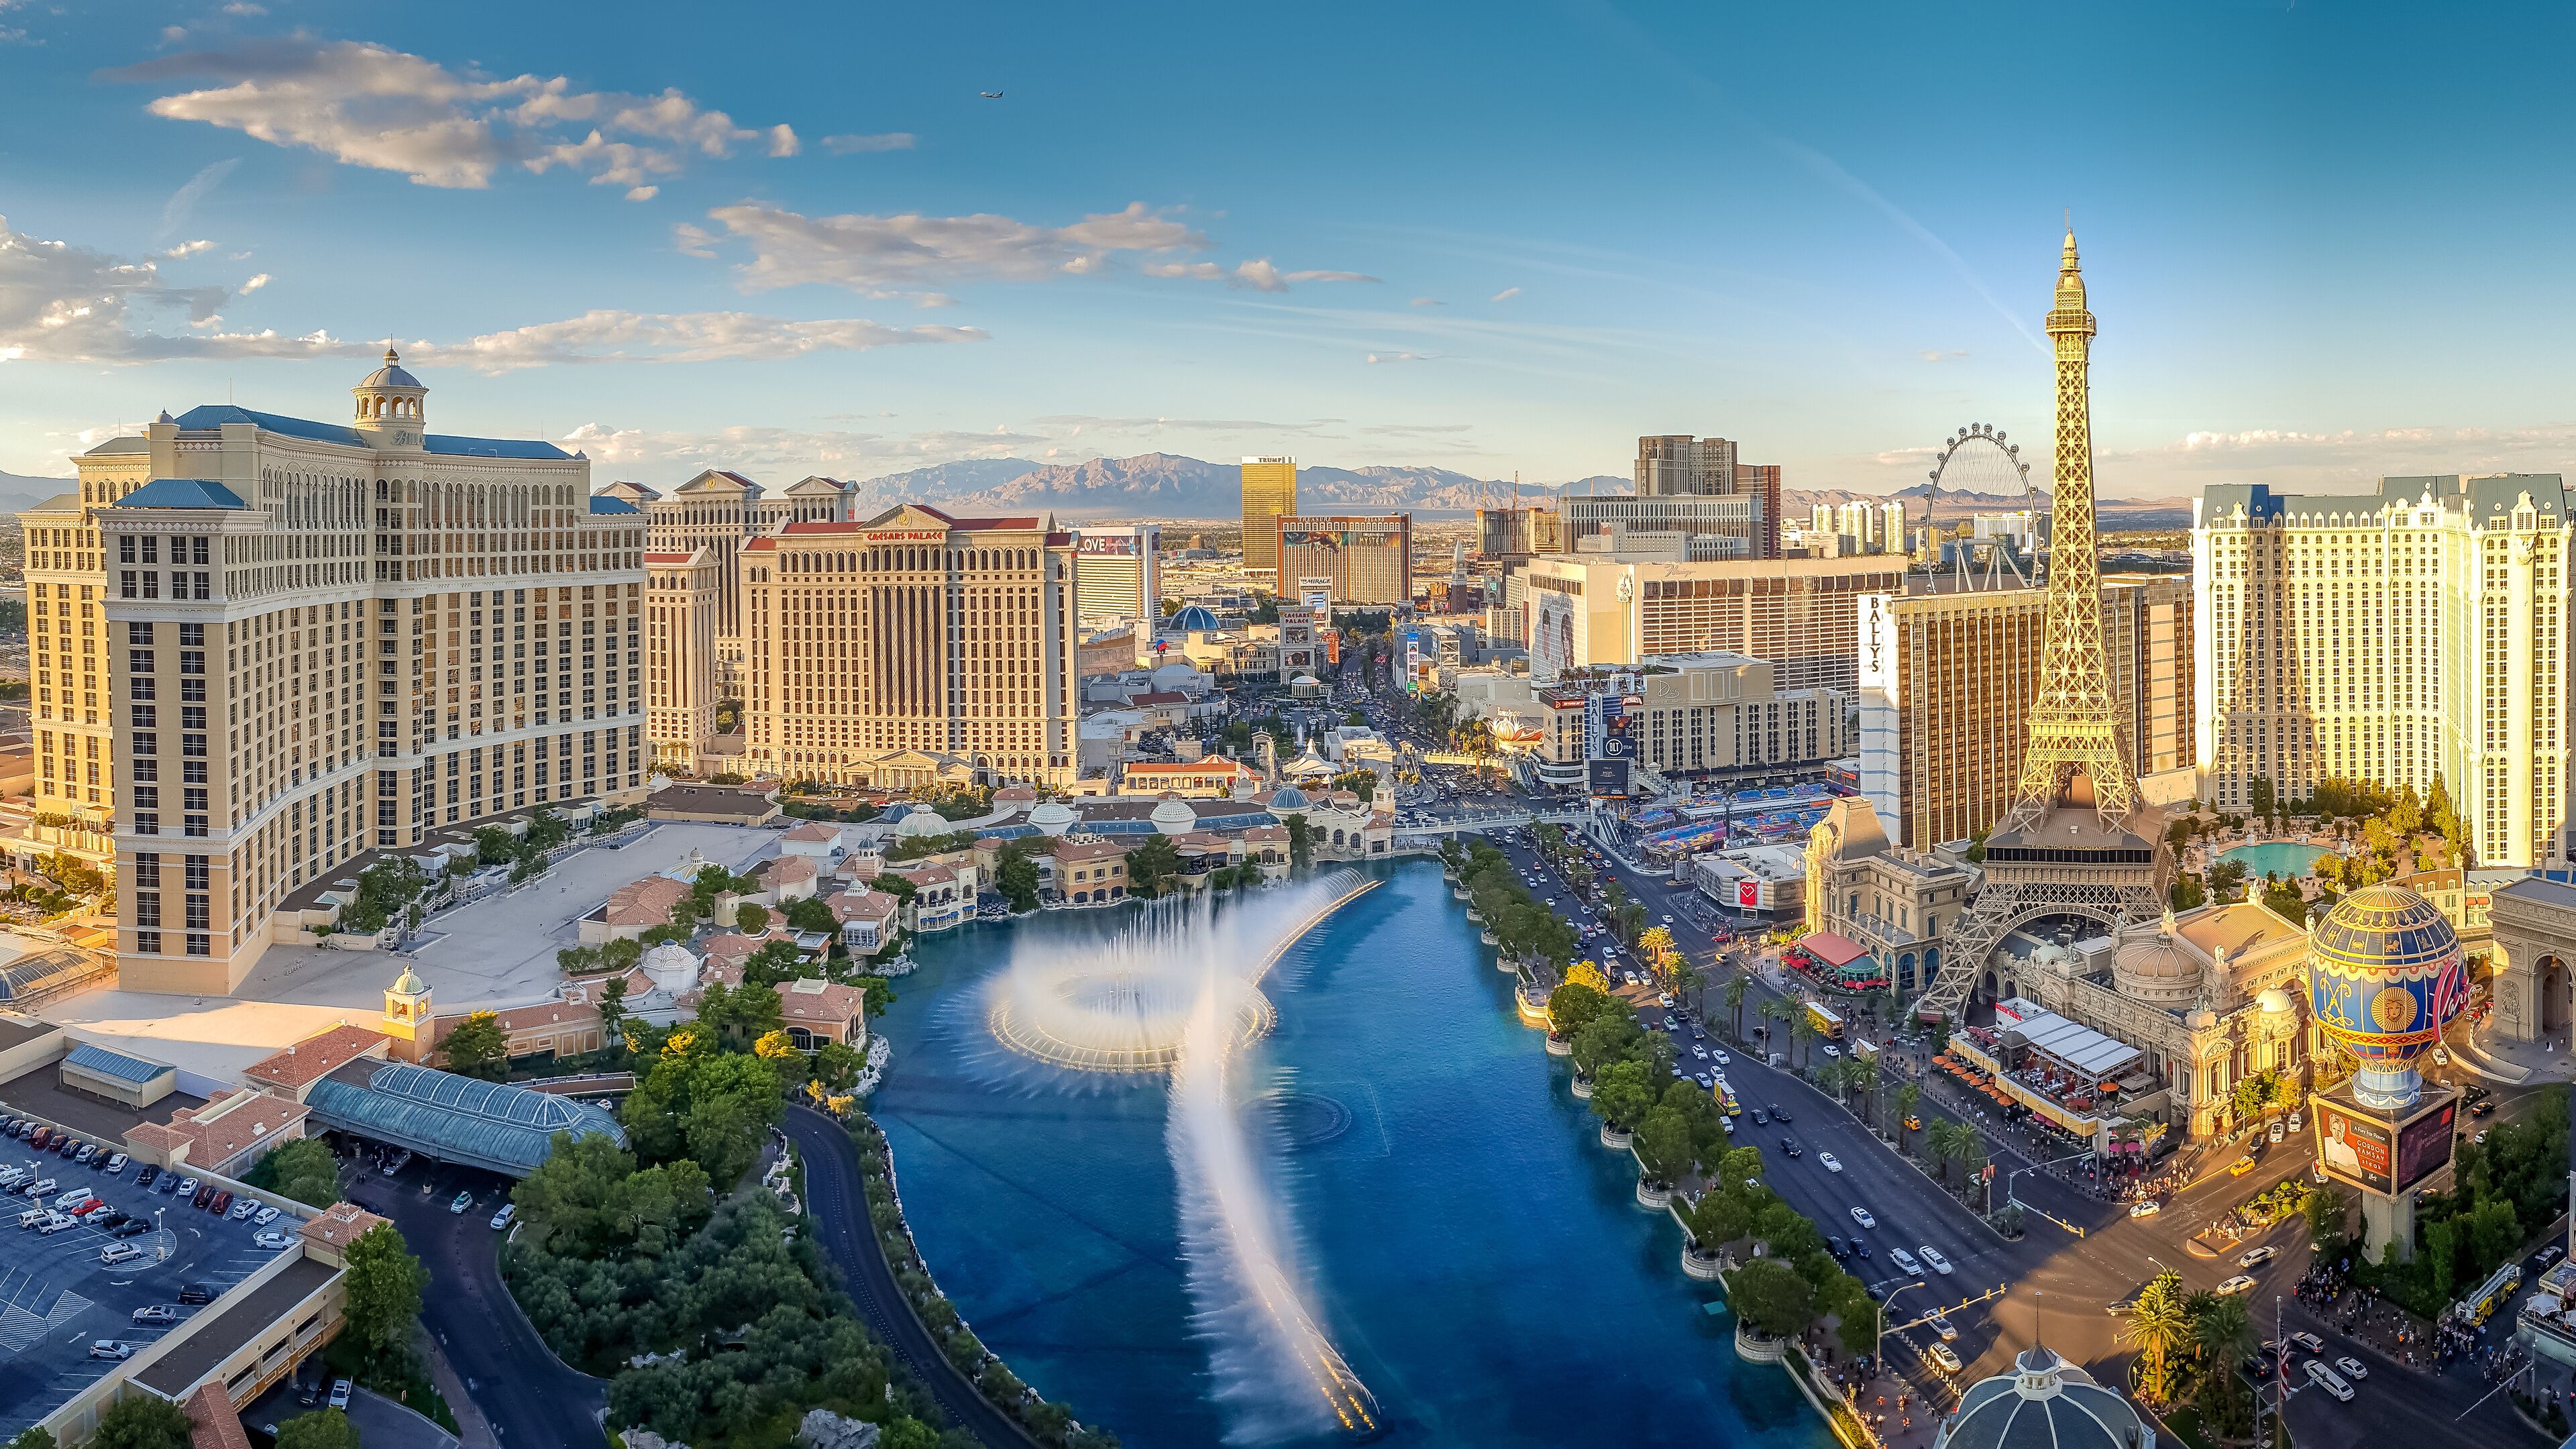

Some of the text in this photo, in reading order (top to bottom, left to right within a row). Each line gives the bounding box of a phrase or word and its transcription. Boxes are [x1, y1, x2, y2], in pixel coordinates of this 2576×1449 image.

[867, 531, 943, 541] CAESARS PALACE
[1869, 597, 1880, 672] BALLYS
[1609, 742, 1619, 752] BLT
[2433, 961, 2475, 1041] Paris
[2373, 1132, 2385, 1141] Flavor
[2357, 1140, 2385, 1155] GORDON
[2357, 1146, 2385, 1161] RAMSAY
[2362, 1159, 2381, 1170] steak
